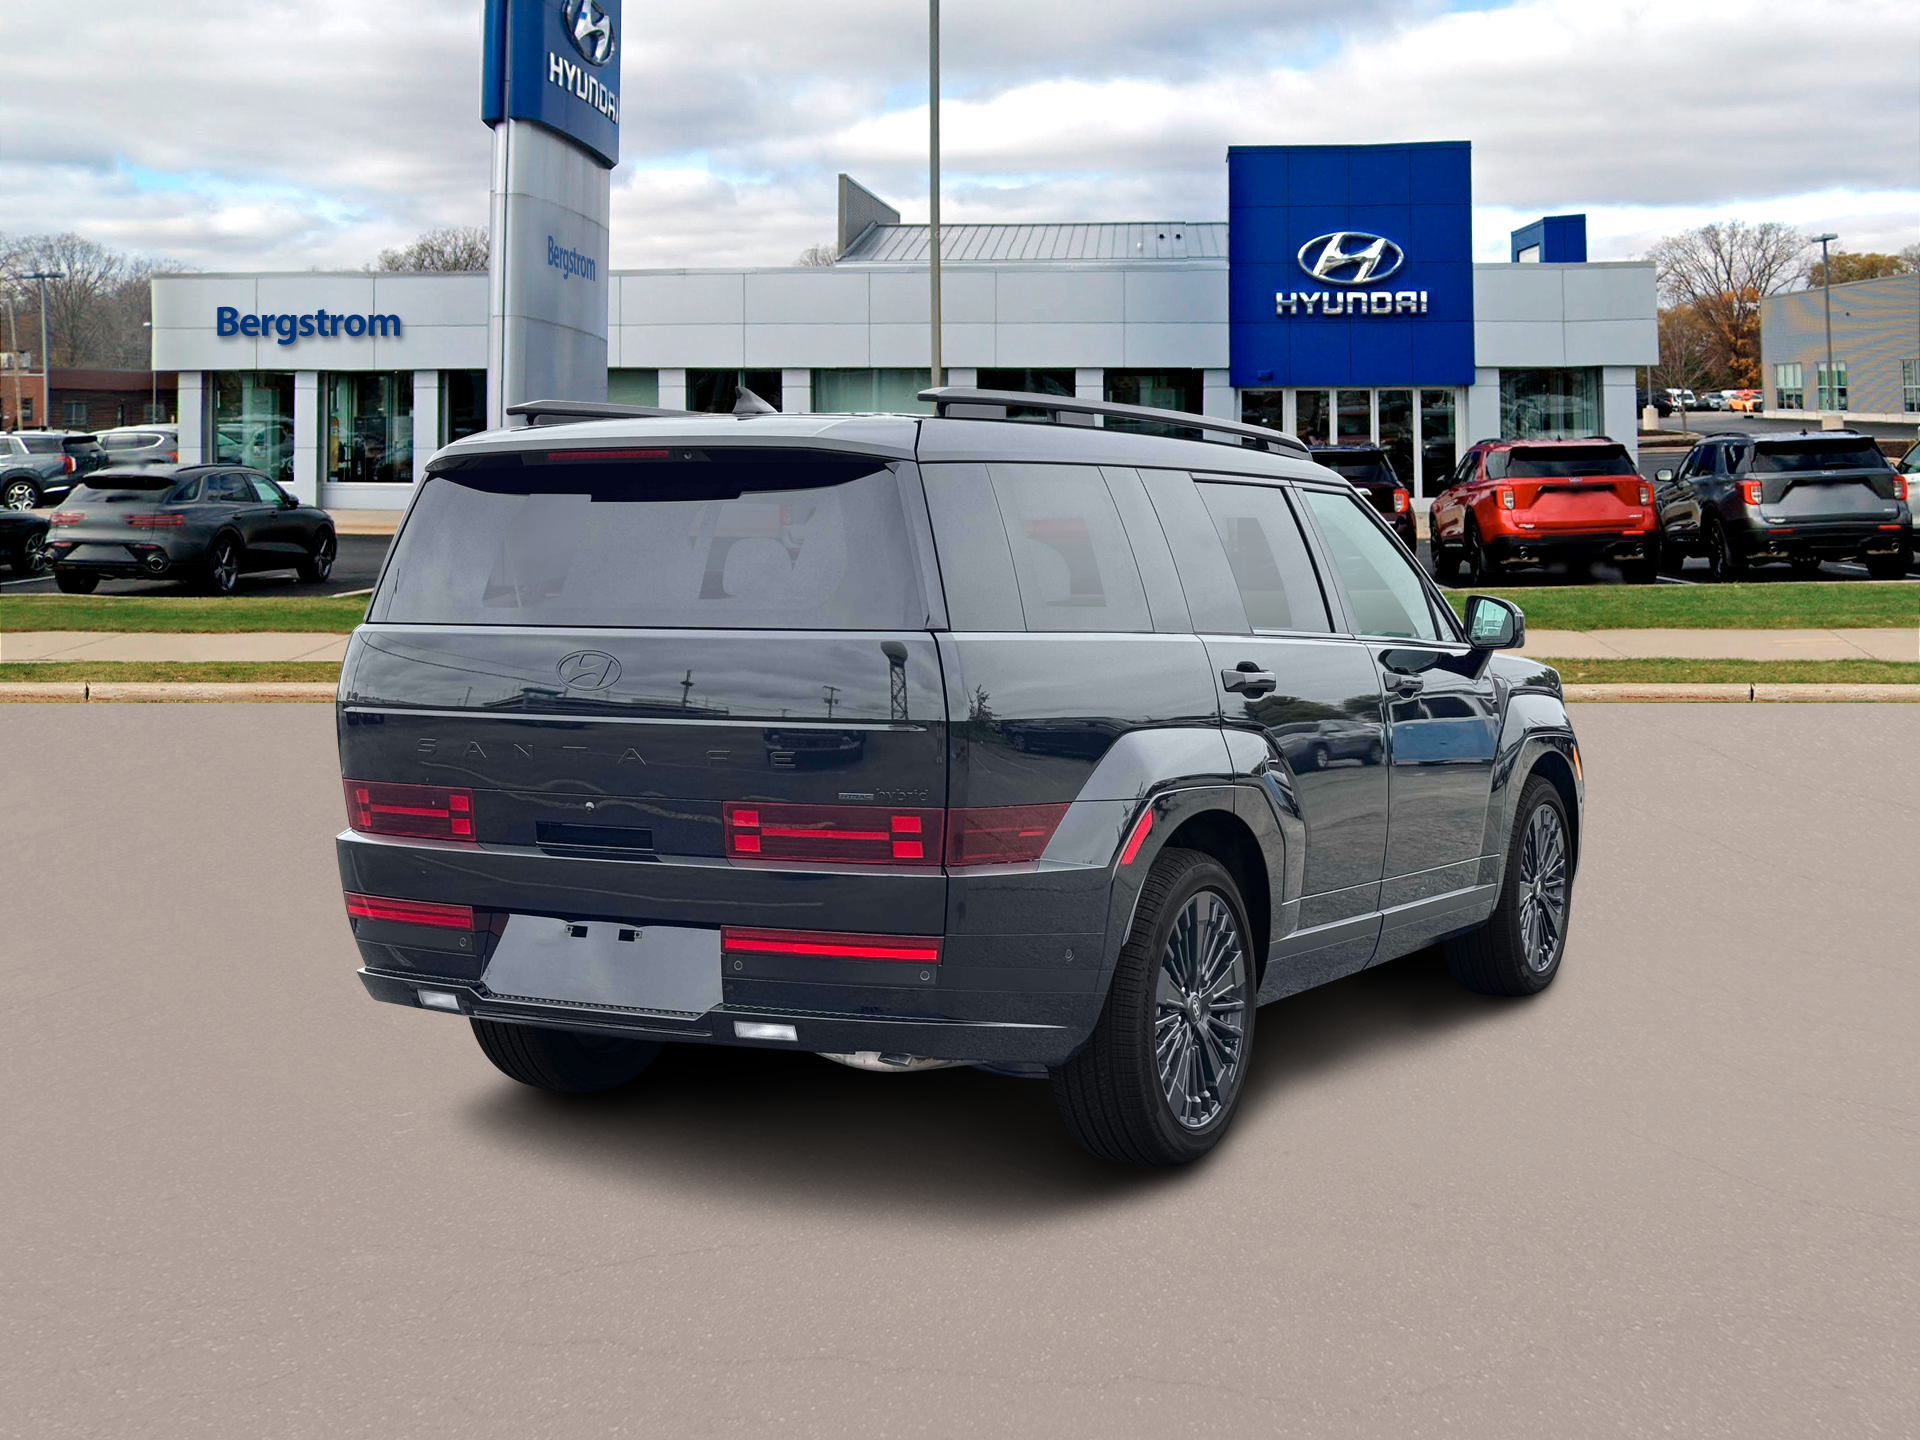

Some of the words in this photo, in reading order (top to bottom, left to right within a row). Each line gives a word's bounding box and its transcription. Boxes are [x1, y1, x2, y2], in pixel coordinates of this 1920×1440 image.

[547, 235, 596, 281] Bergstrom
[1275, 291, 1427, 315] HYUNDAI
[216, 306, 402, 346] Bergstrom
[417, 737, 647, 765] SANTA
[705, 749, 797, 769] FE
